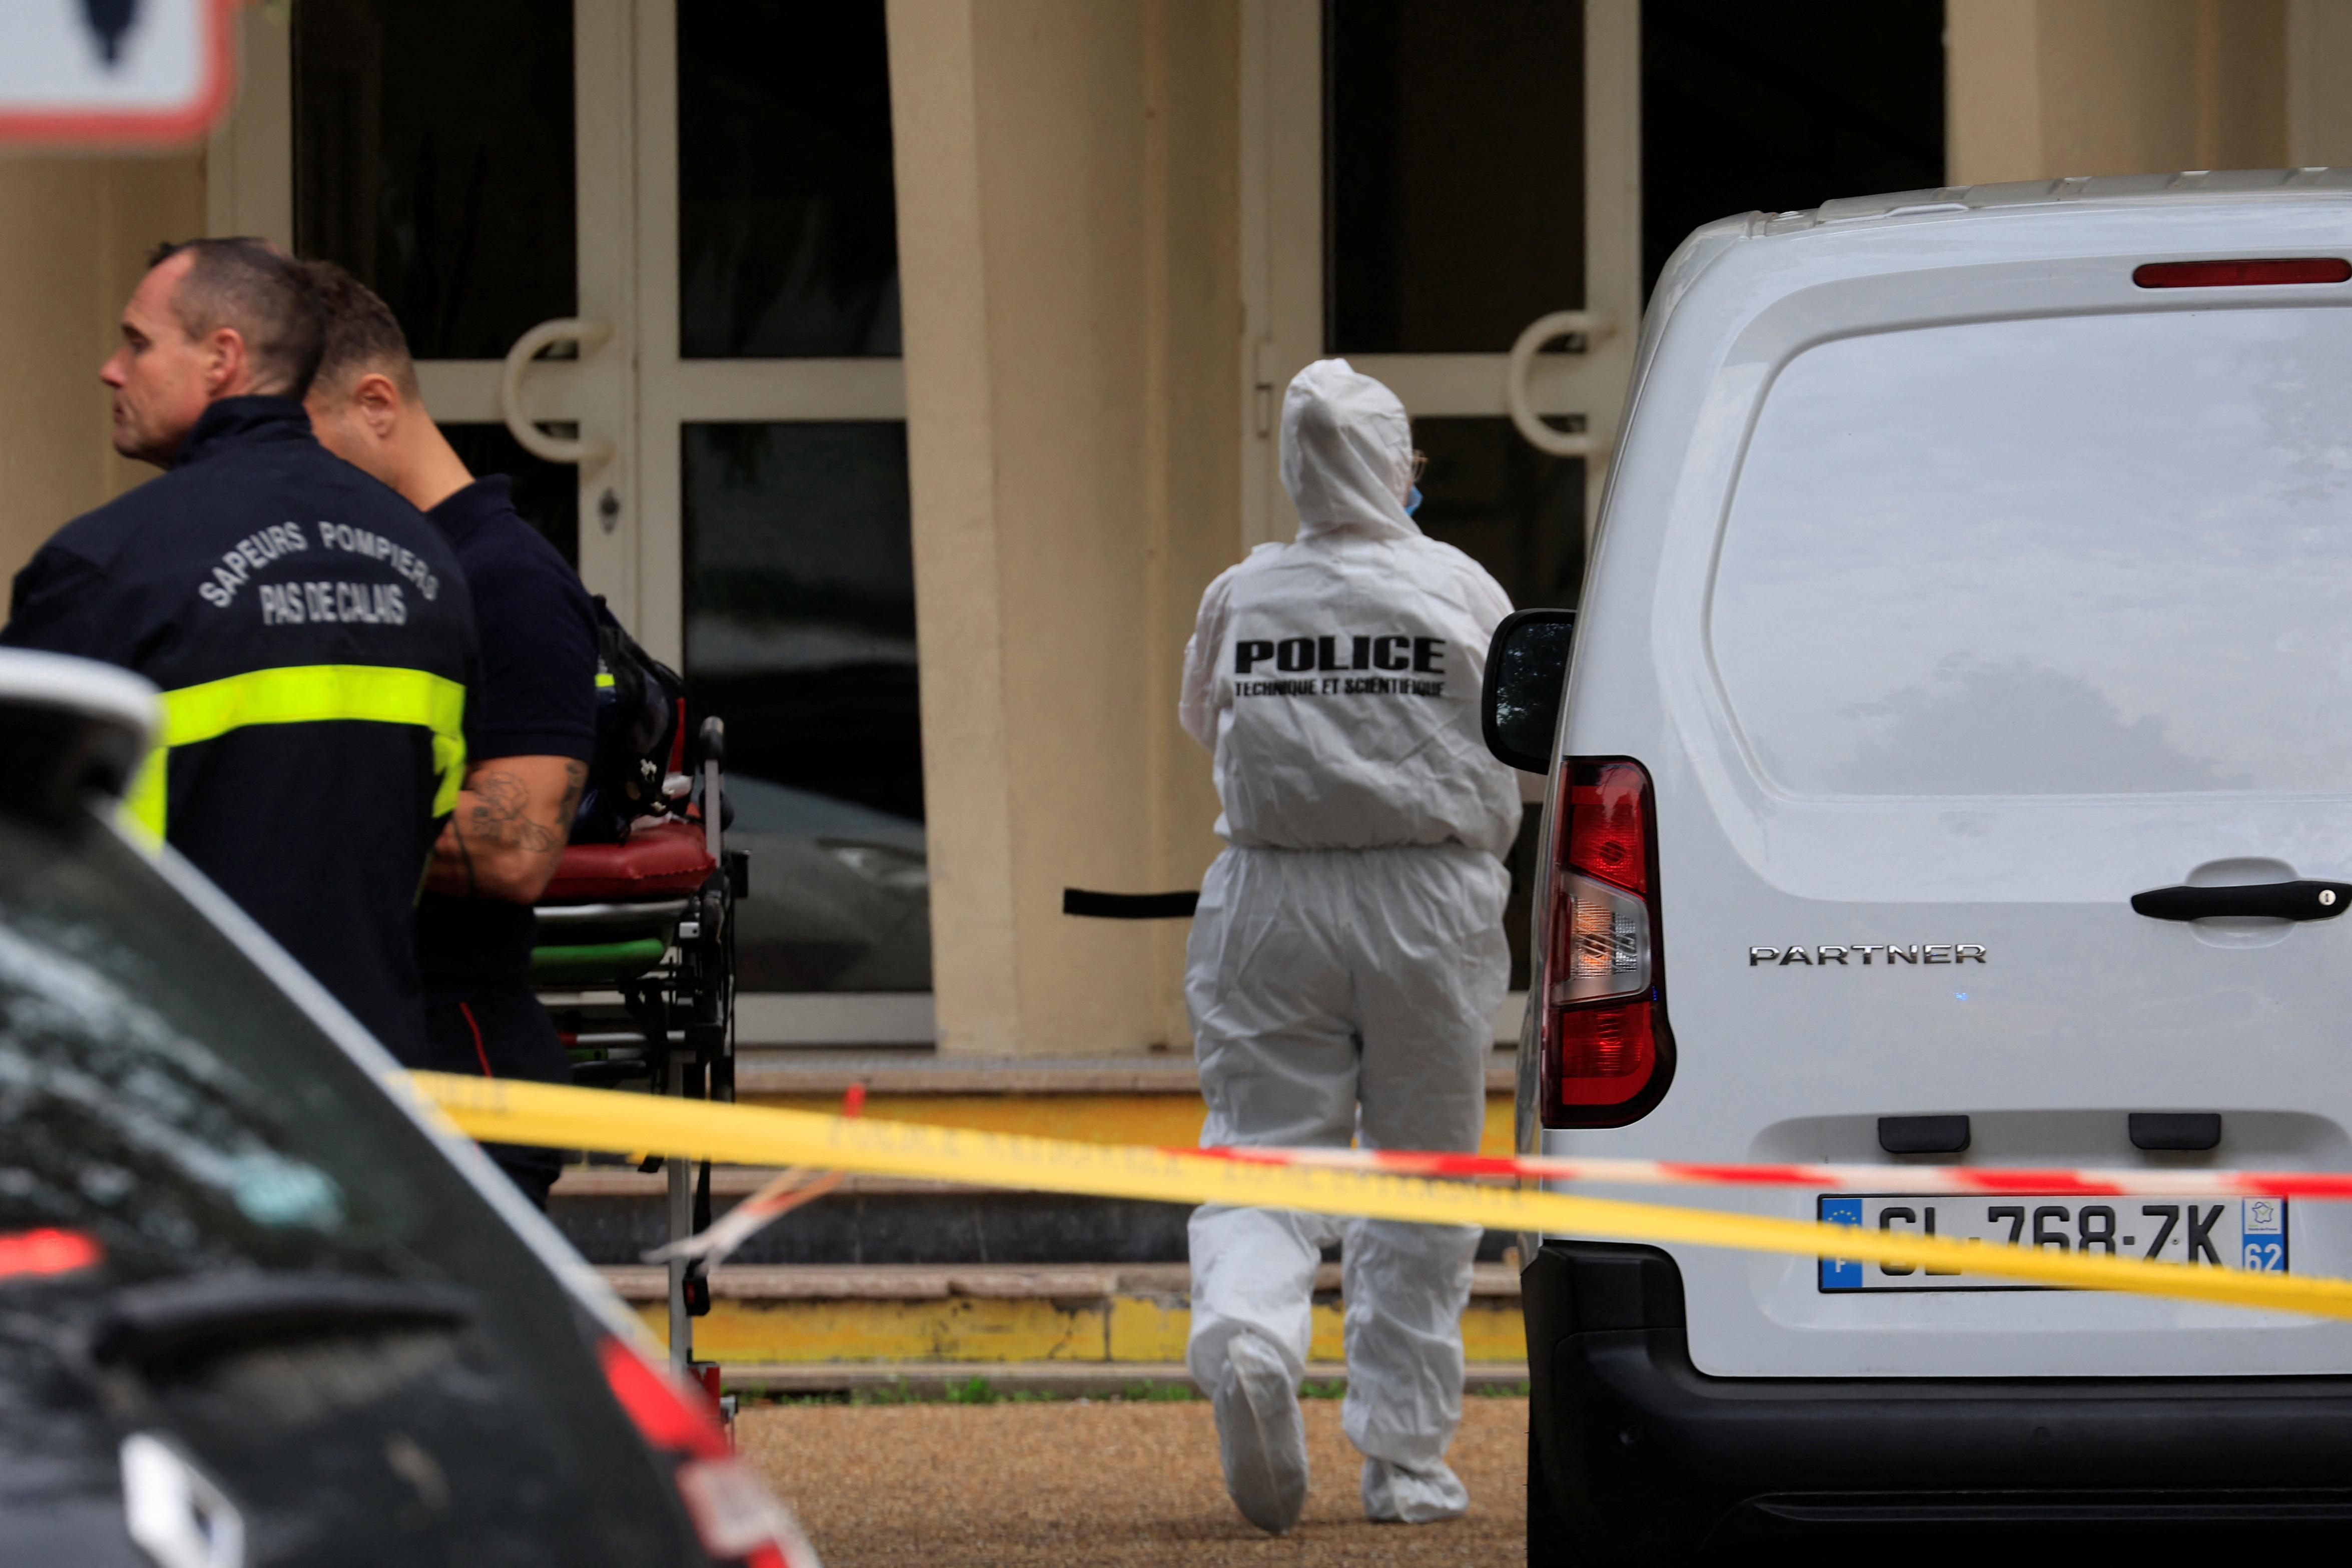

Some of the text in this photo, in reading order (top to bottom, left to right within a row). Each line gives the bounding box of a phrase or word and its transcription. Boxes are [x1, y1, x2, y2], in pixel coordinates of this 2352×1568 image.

[200, 521, 439, 608] SAPEURS POMPIERS
[259, 582, 406, 625] PAS DE CALAIS
[1235, 635, 1446, 674] POLICE
[1235, 678, 1445, 697] TECHNIQUE ET SCIENTIFIQUE
[1750, 944, 1987, 966] PARTNER
[2244, 1243, 2282, 1272] 62
